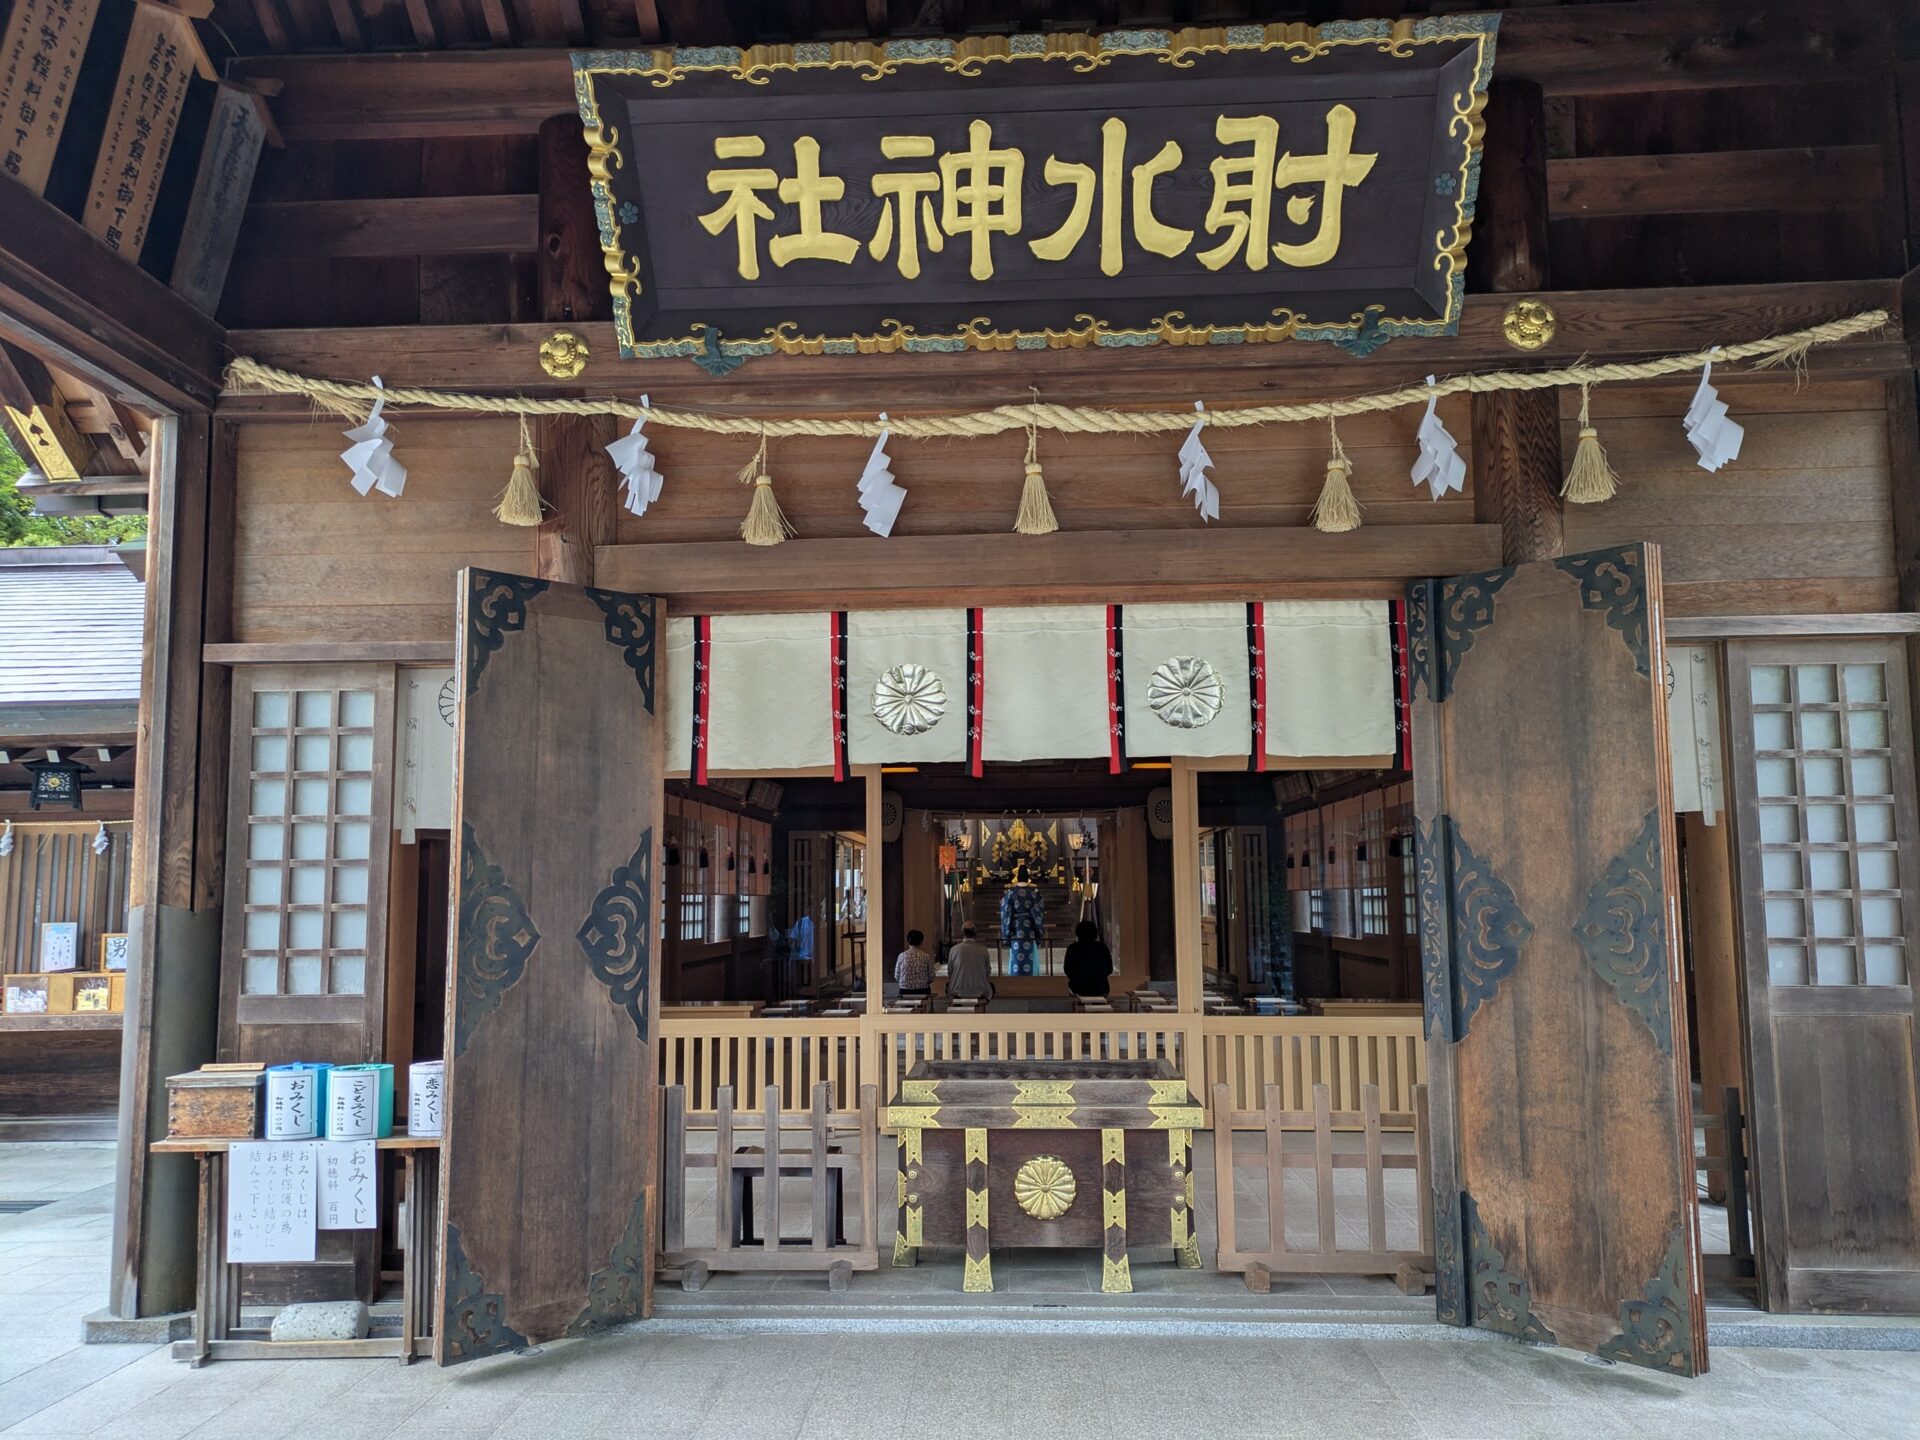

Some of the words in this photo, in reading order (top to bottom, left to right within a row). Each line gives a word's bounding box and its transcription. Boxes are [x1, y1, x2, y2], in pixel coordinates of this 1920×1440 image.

[699, 104, 1378, 281] 射水神社
[289, 1079, 305, 1127] おみくじ
[350, 1080, 367, 1128] こどもみくじ
[425, 1077, 440, 1124] 恋みくじ
[263, 1150, 278, 1249] おみくじ結びに
[280, 1150, 294, 1235] 樹木保護の為
[348, 1148, 369, 1225] おみくじ
[232, 1211, 244, 1257] 社務所
